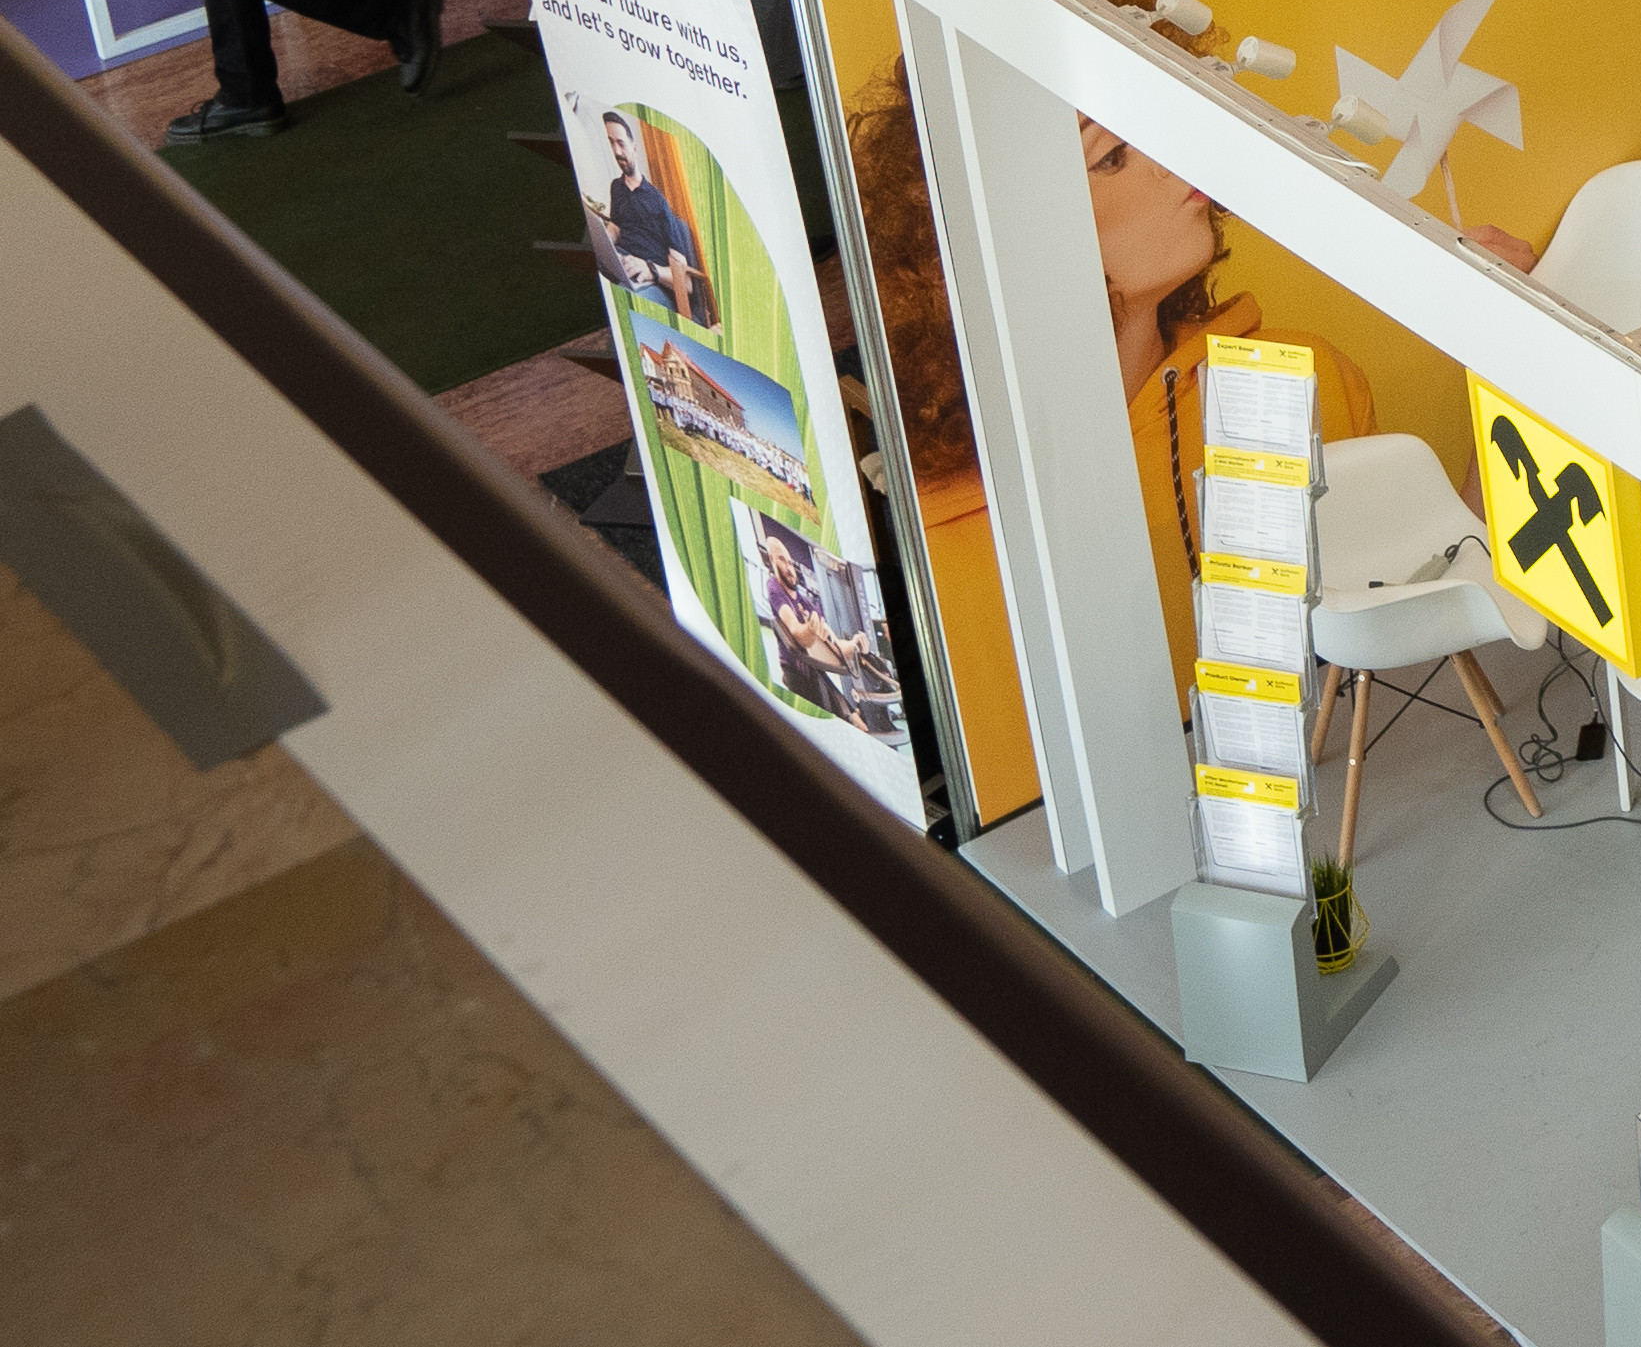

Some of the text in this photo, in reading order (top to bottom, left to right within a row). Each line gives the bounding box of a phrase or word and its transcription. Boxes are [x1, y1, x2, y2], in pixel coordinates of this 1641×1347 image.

[575, 4, 615, 39] let's
[618, 28, 661, 61] grow
[666, 44, 748, 100] together.
[676, 19, 712, 53] with
[716, 39, 749, 71] us,
